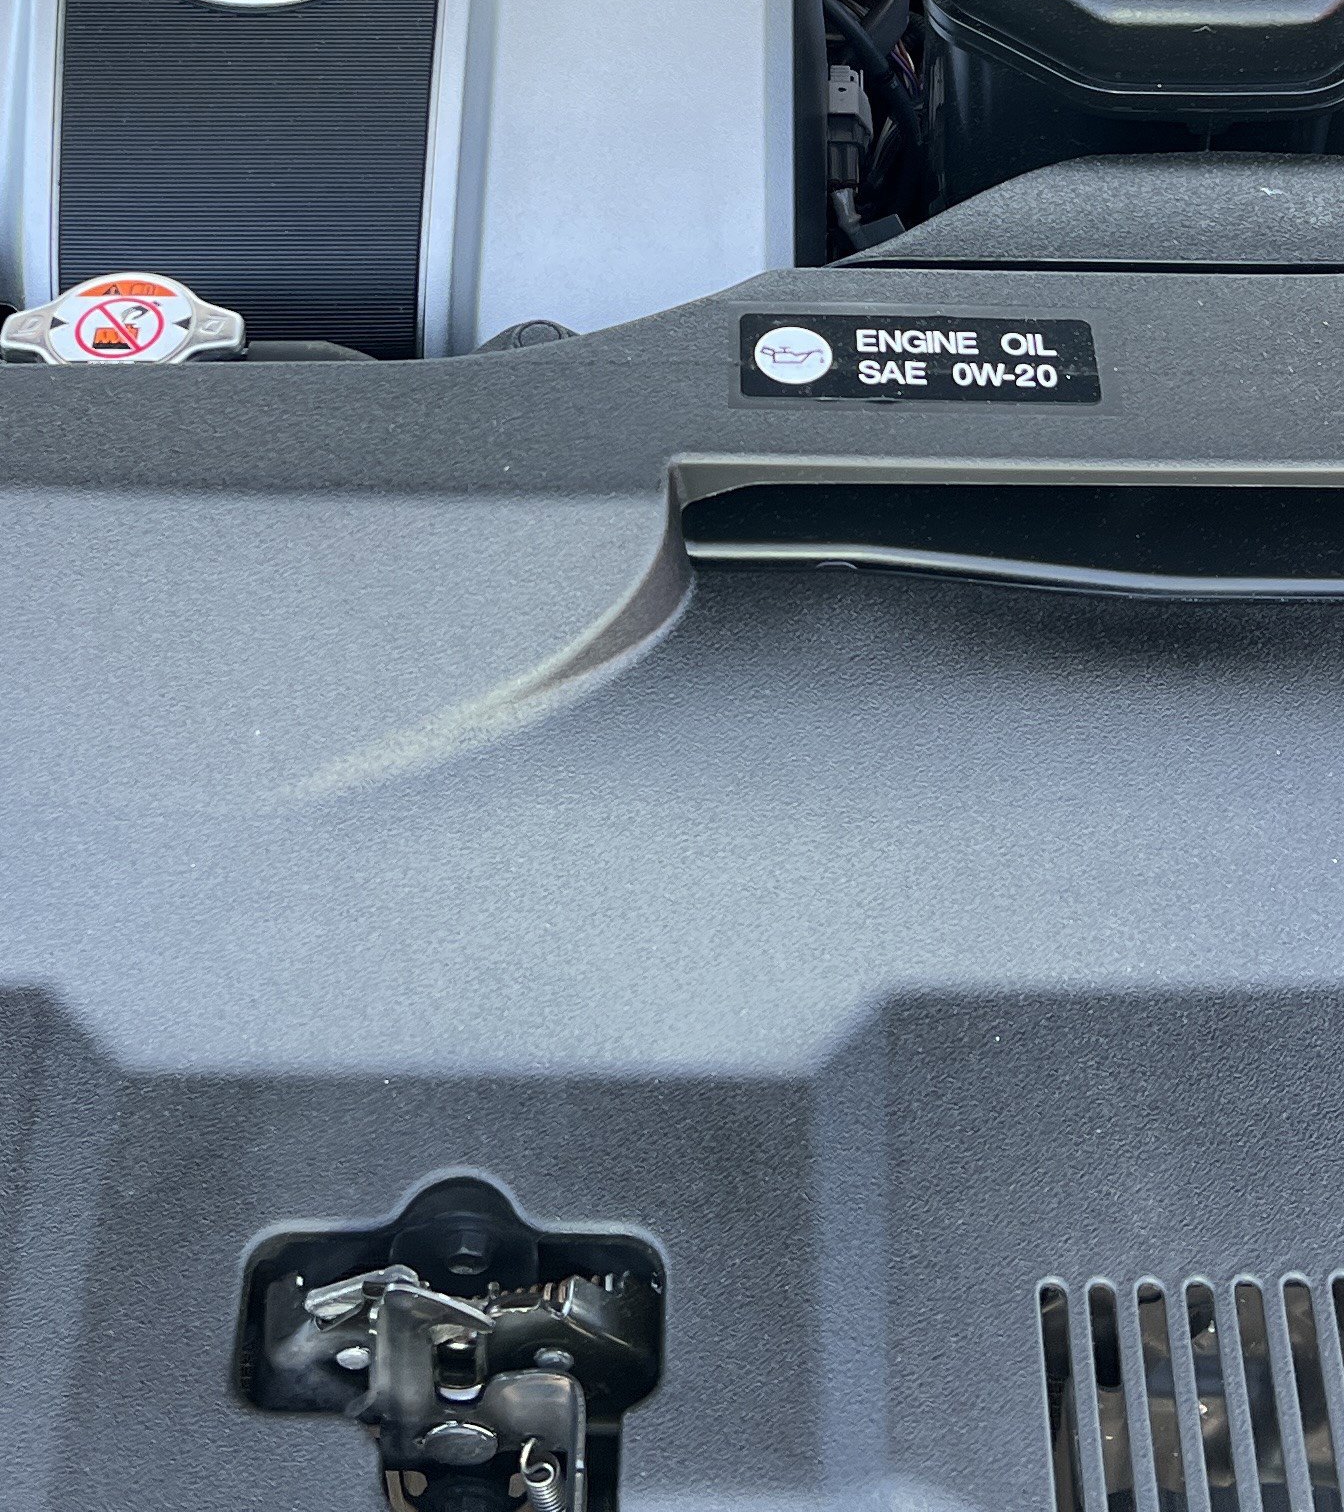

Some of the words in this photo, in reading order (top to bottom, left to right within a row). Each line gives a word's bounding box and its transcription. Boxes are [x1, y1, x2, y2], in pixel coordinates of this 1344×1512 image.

[855, 329, 980, 356] ENGINE
[1000, 332, 1058, 357] OIL
[858, 359, 928, 386] SAE
[951, 362, 1059, 388] 0W-20
